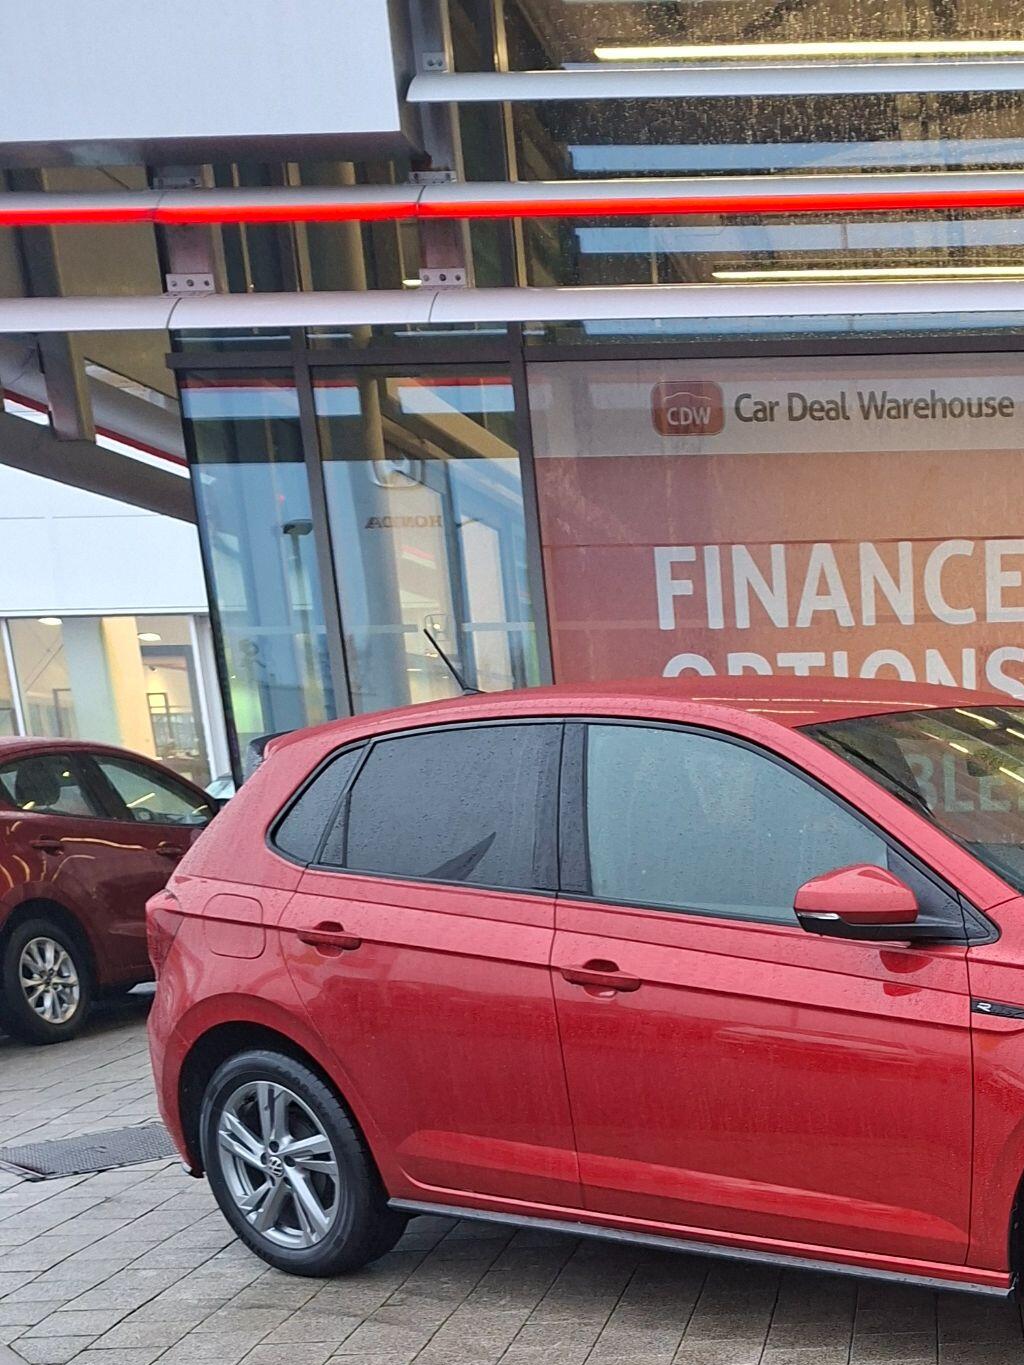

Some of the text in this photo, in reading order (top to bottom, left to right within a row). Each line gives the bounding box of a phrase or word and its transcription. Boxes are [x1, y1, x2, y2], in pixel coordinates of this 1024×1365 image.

[667, 407, 712, 425] CDW
[734, 389, 1015, 422] Car Deal Warehouse
